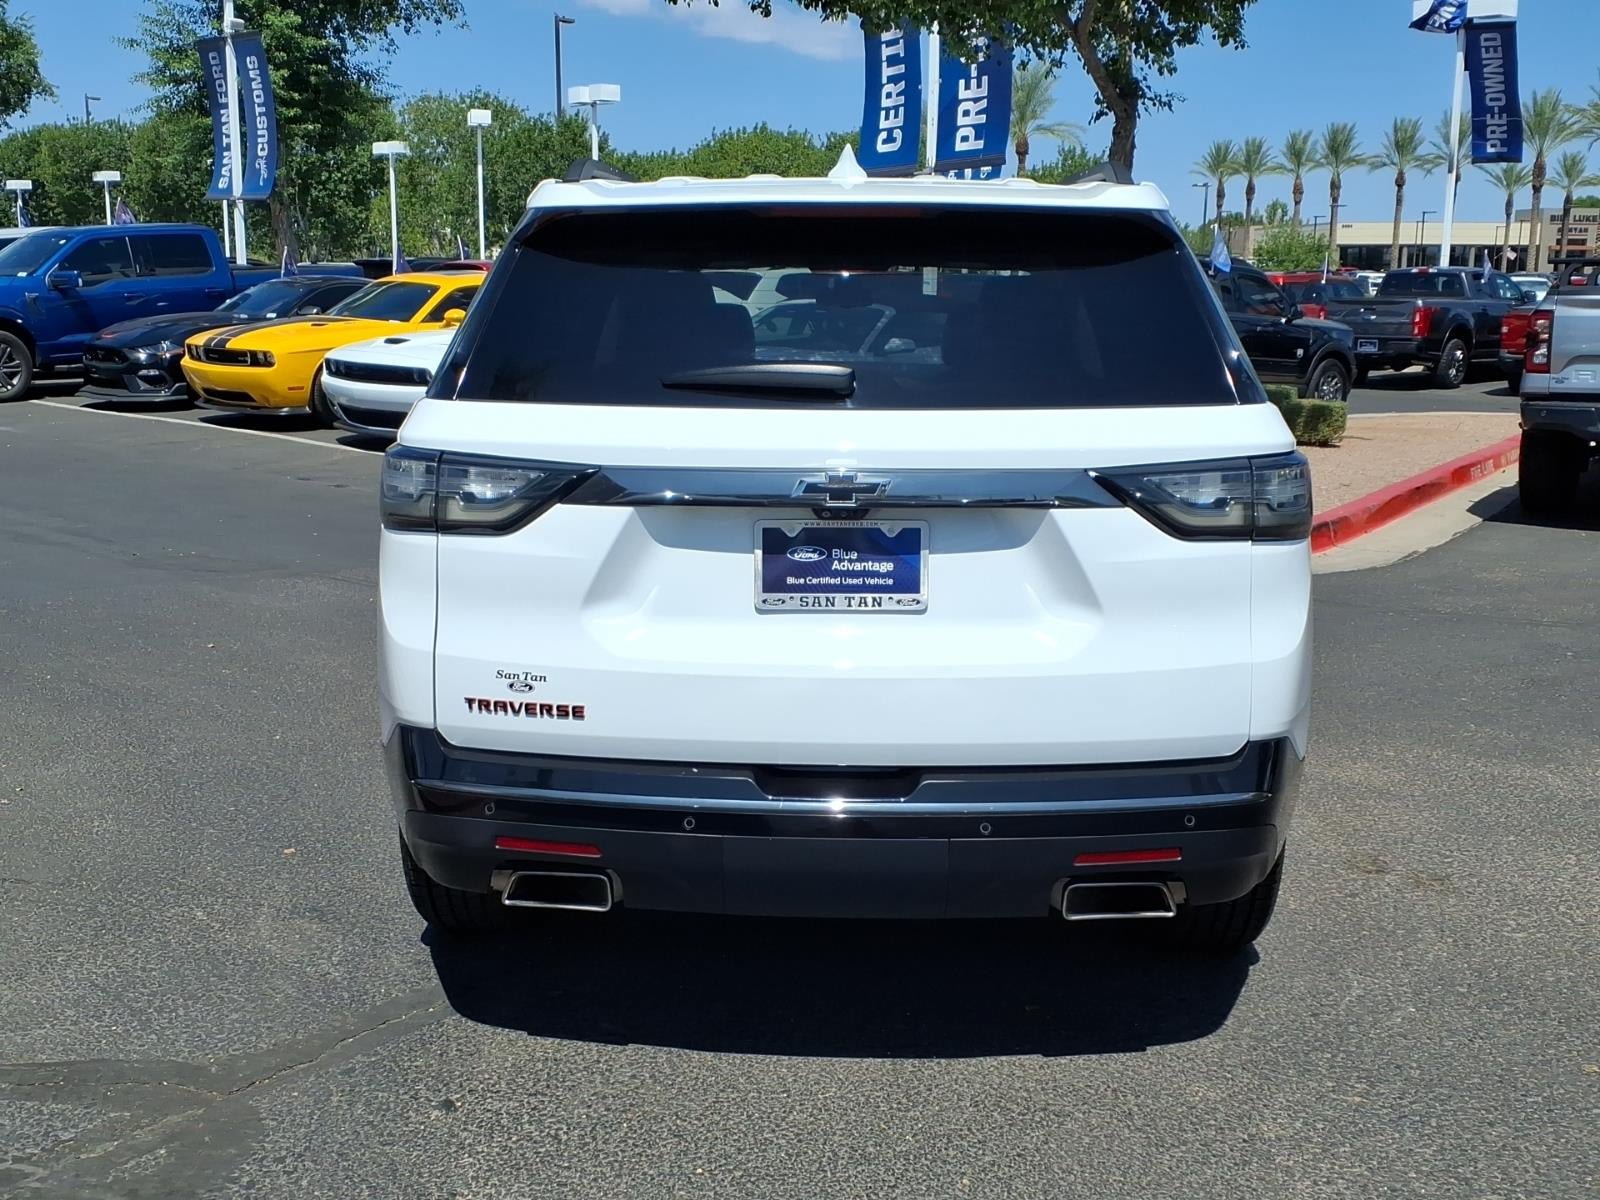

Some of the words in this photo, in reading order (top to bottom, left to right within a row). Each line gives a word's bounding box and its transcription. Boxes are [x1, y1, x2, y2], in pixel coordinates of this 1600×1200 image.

[208, 51, 228, 104] FORD
[1480, 32, 1508, 153] PRE-OWNED
[246, 55, 269, 157] CUSTOMS
[217, 109, 232, 147] TAN
[217, 149, 233, 190] SAN
[1573, 214, 1598, 222] LUKE
[832, 549, 858, 559] Blue
[831, 560, 894, 573] Advantage
[786, 576, 805, 585] Blue
[806, 576, 840, 585] Certified
[842, 577, 863, 585] Used
[865, 577, 894, 585] Vehicle
[800, 596, 836, 608] SAN
[844, 596, 883, 608] TAN
[495, 669, 520, 680] San
[522, 671, 548, 682] Tan
[464, 697, 586, 721] TRAVERSE
